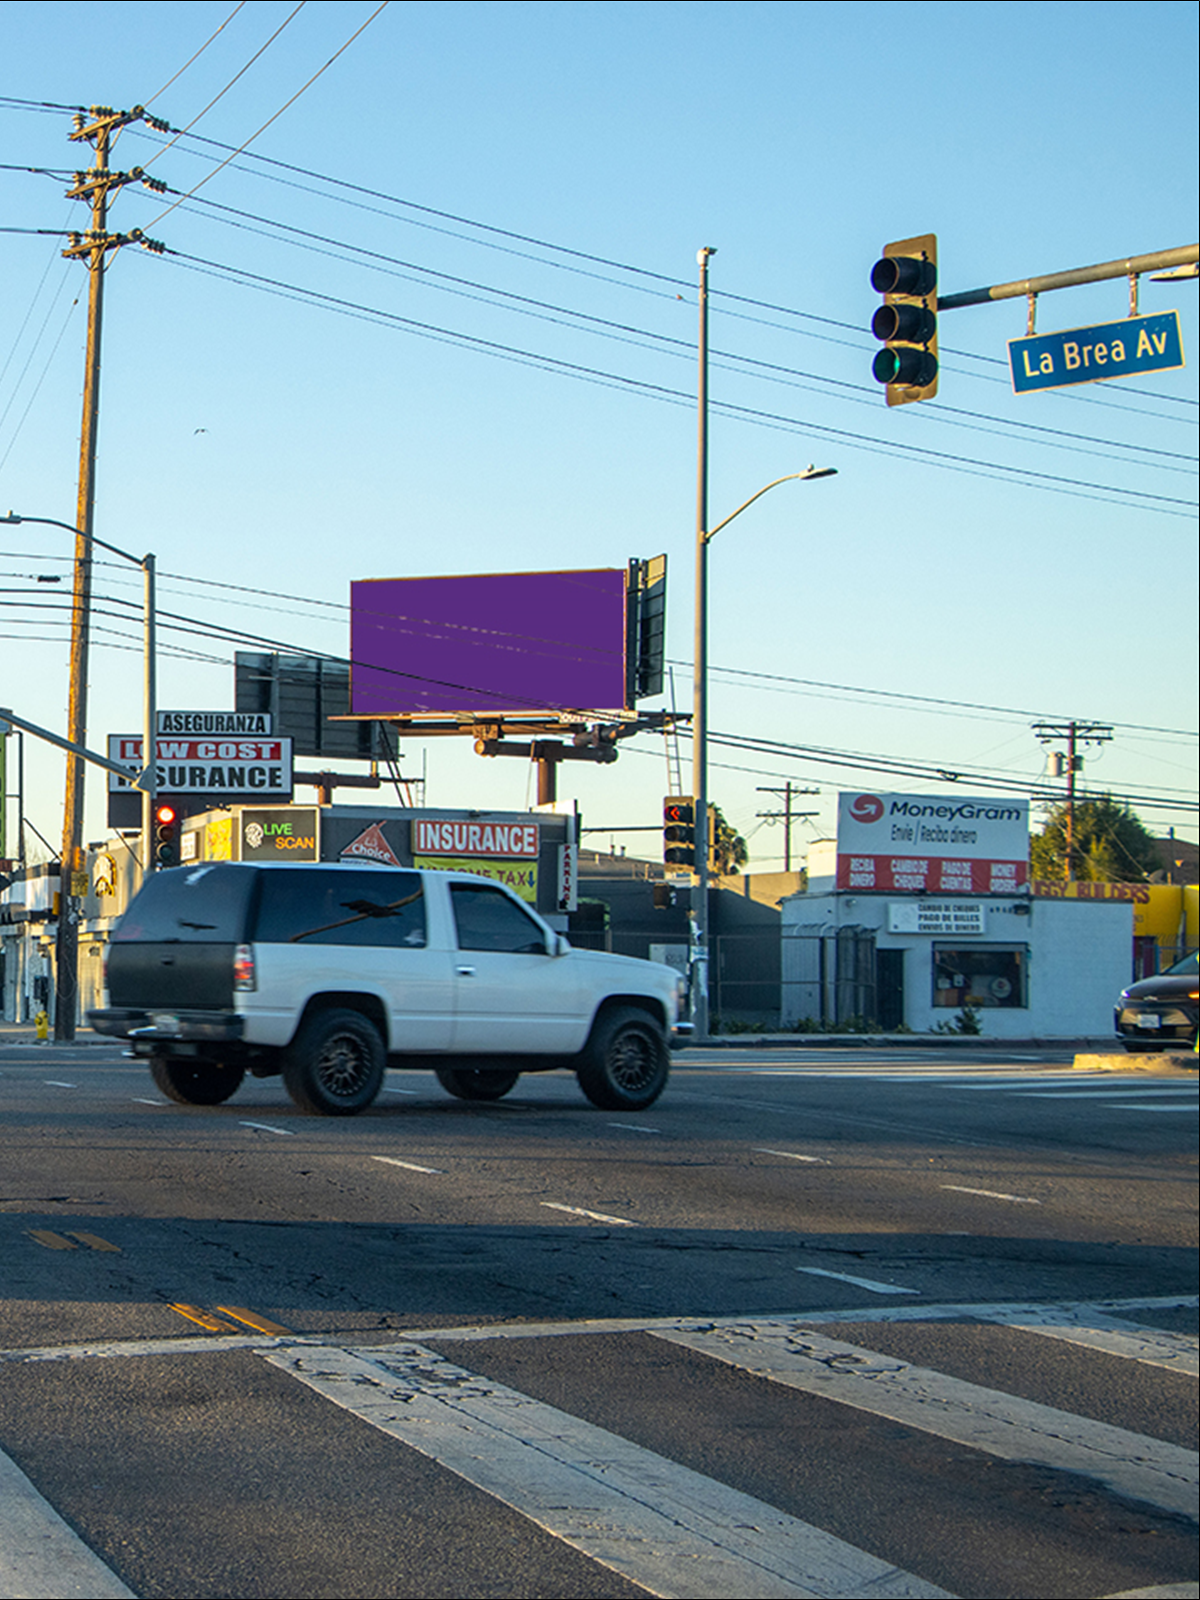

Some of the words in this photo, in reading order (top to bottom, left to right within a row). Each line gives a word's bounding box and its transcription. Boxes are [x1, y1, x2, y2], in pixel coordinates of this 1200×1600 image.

[1023, 350, 1054, 377] La
[1063, 340, 1126, 369] Brea
[1136, 329, 1167, 358] Av
[163, 713, 266, 732] ASEGURANZA
[125, 742, 190, 758] LW
[197, 743, 275, 759] COST
[118, 766, 282, 787] SURANCE
[890, 801, 1021, 821] MoneyGram
[263, 823, 293, 835] LIVE
[419, 823, 535, 853] INSURANCE
[275, 836, 314, 849] SCAN
[352, 843, 391, 861] Choice
[497, 870, 526, 886] TAX
[563, 844, 571, 900] PARKING
